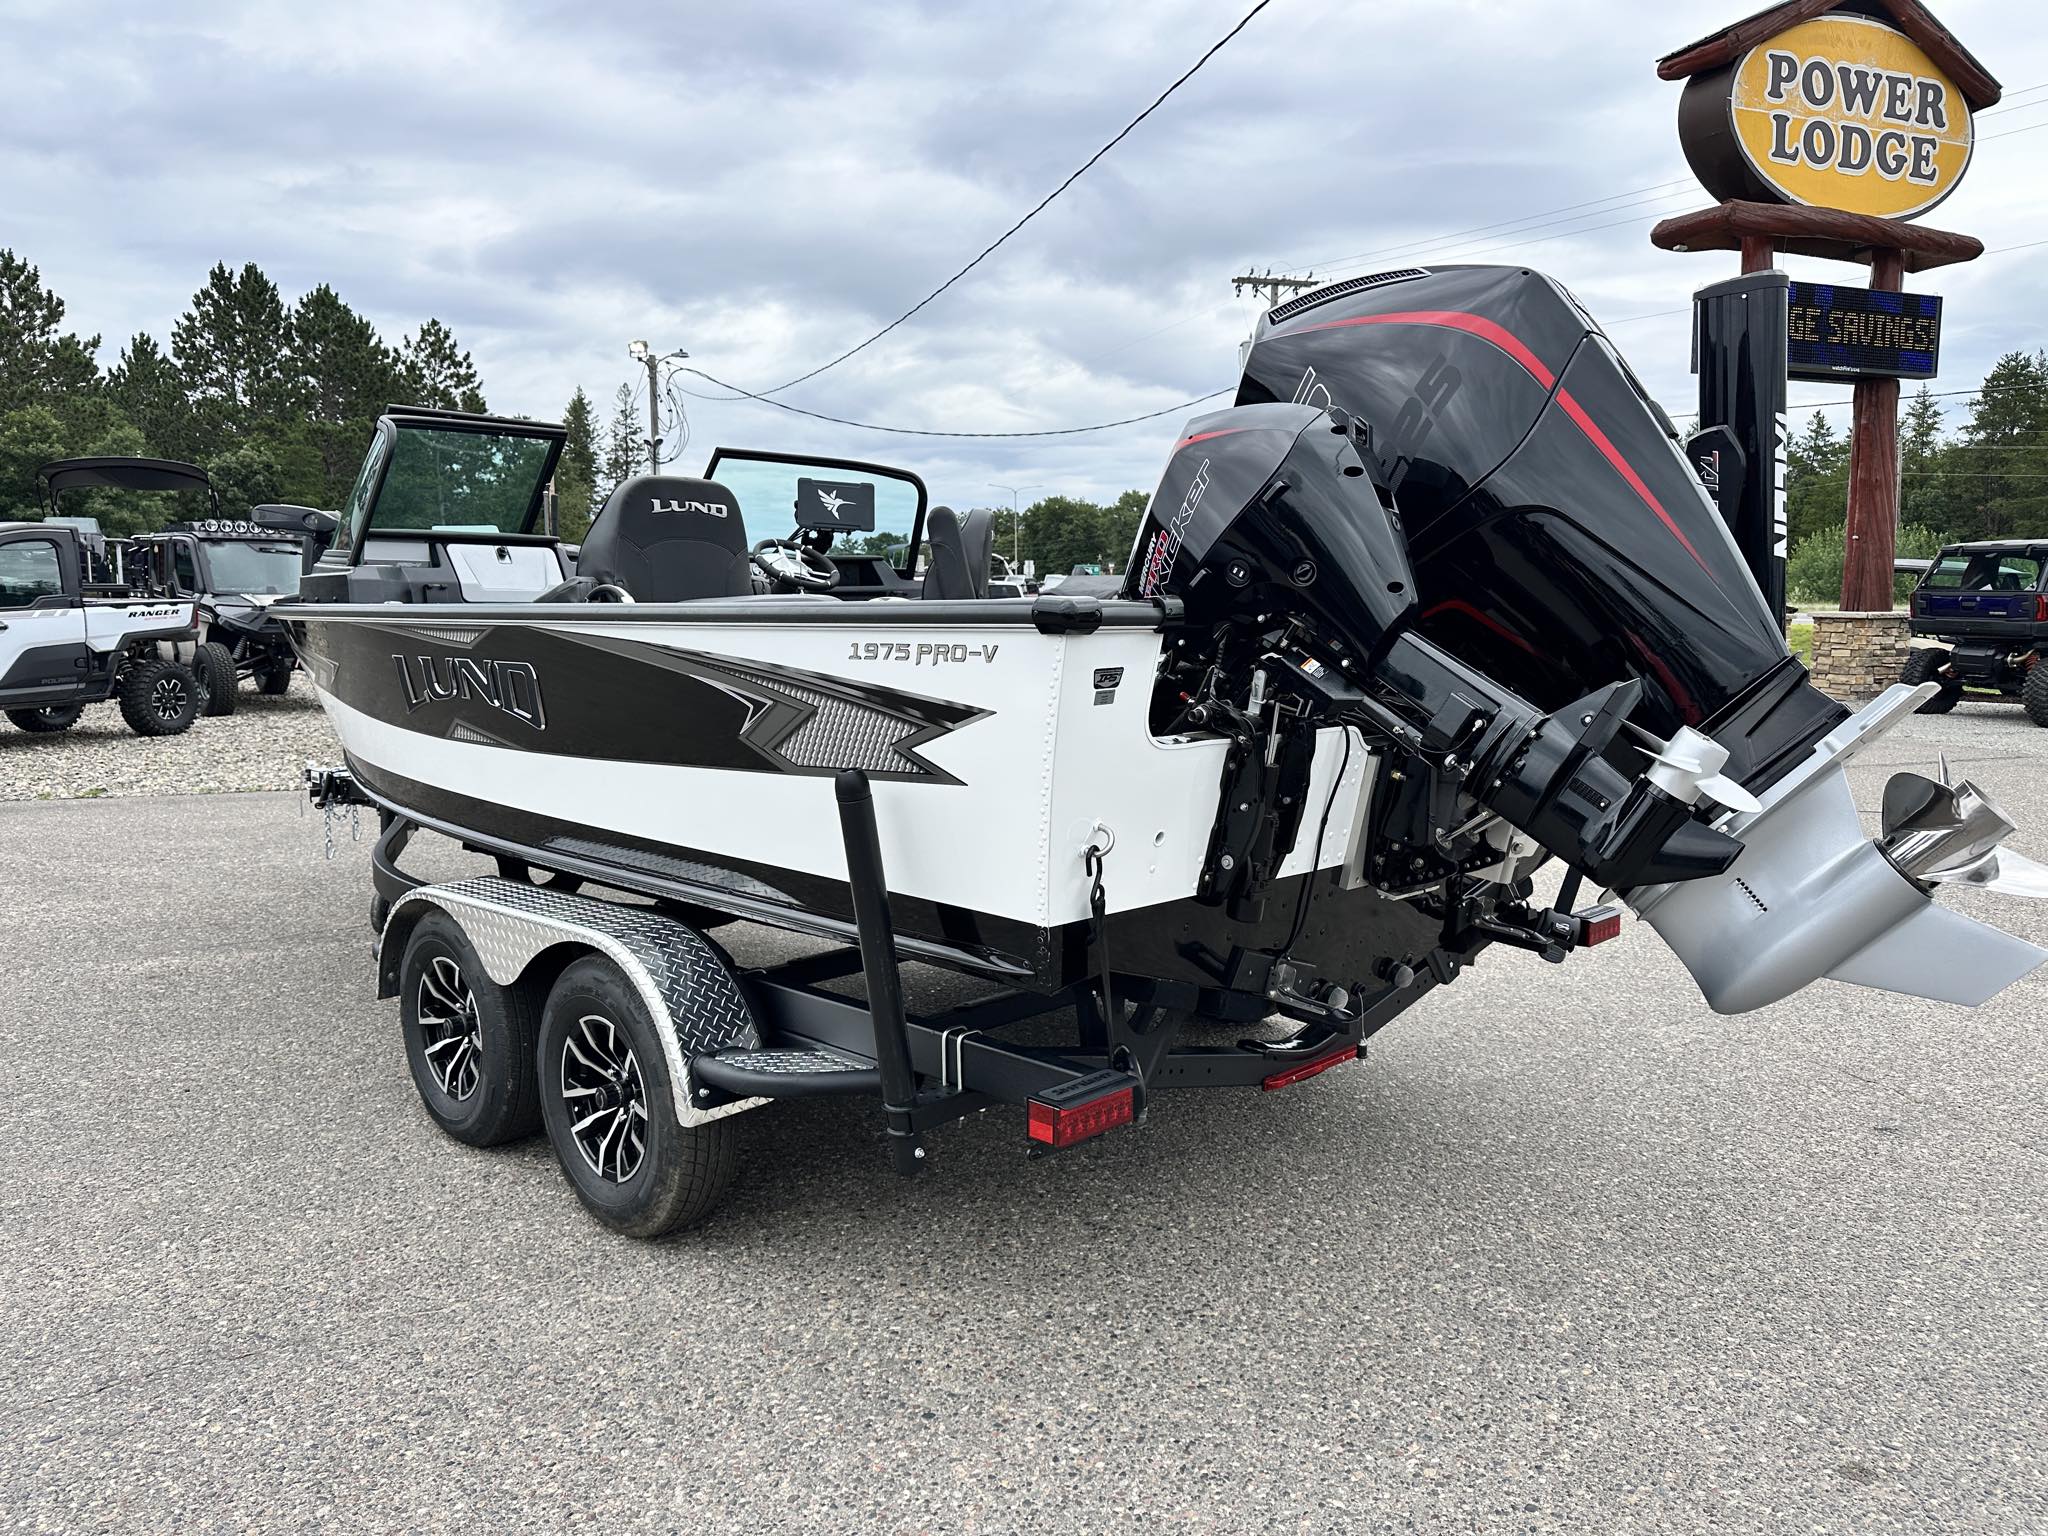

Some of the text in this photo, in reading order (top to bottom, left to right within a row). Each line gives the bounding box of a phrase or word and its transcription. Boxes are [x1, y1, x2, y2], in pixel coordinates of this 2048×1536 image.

[1766, 52, 1947, 130] POWER
[1770, 112, 1939, 182] LODGE
[650, 498, 728, 519] LUND
[1138, 531, 1157, 596] MERCURY
[128, 609, 180, 618] RANGER
[848, 642, 999, 667] 1975 PRO-V
[391, 654, 546, 732] LUND
